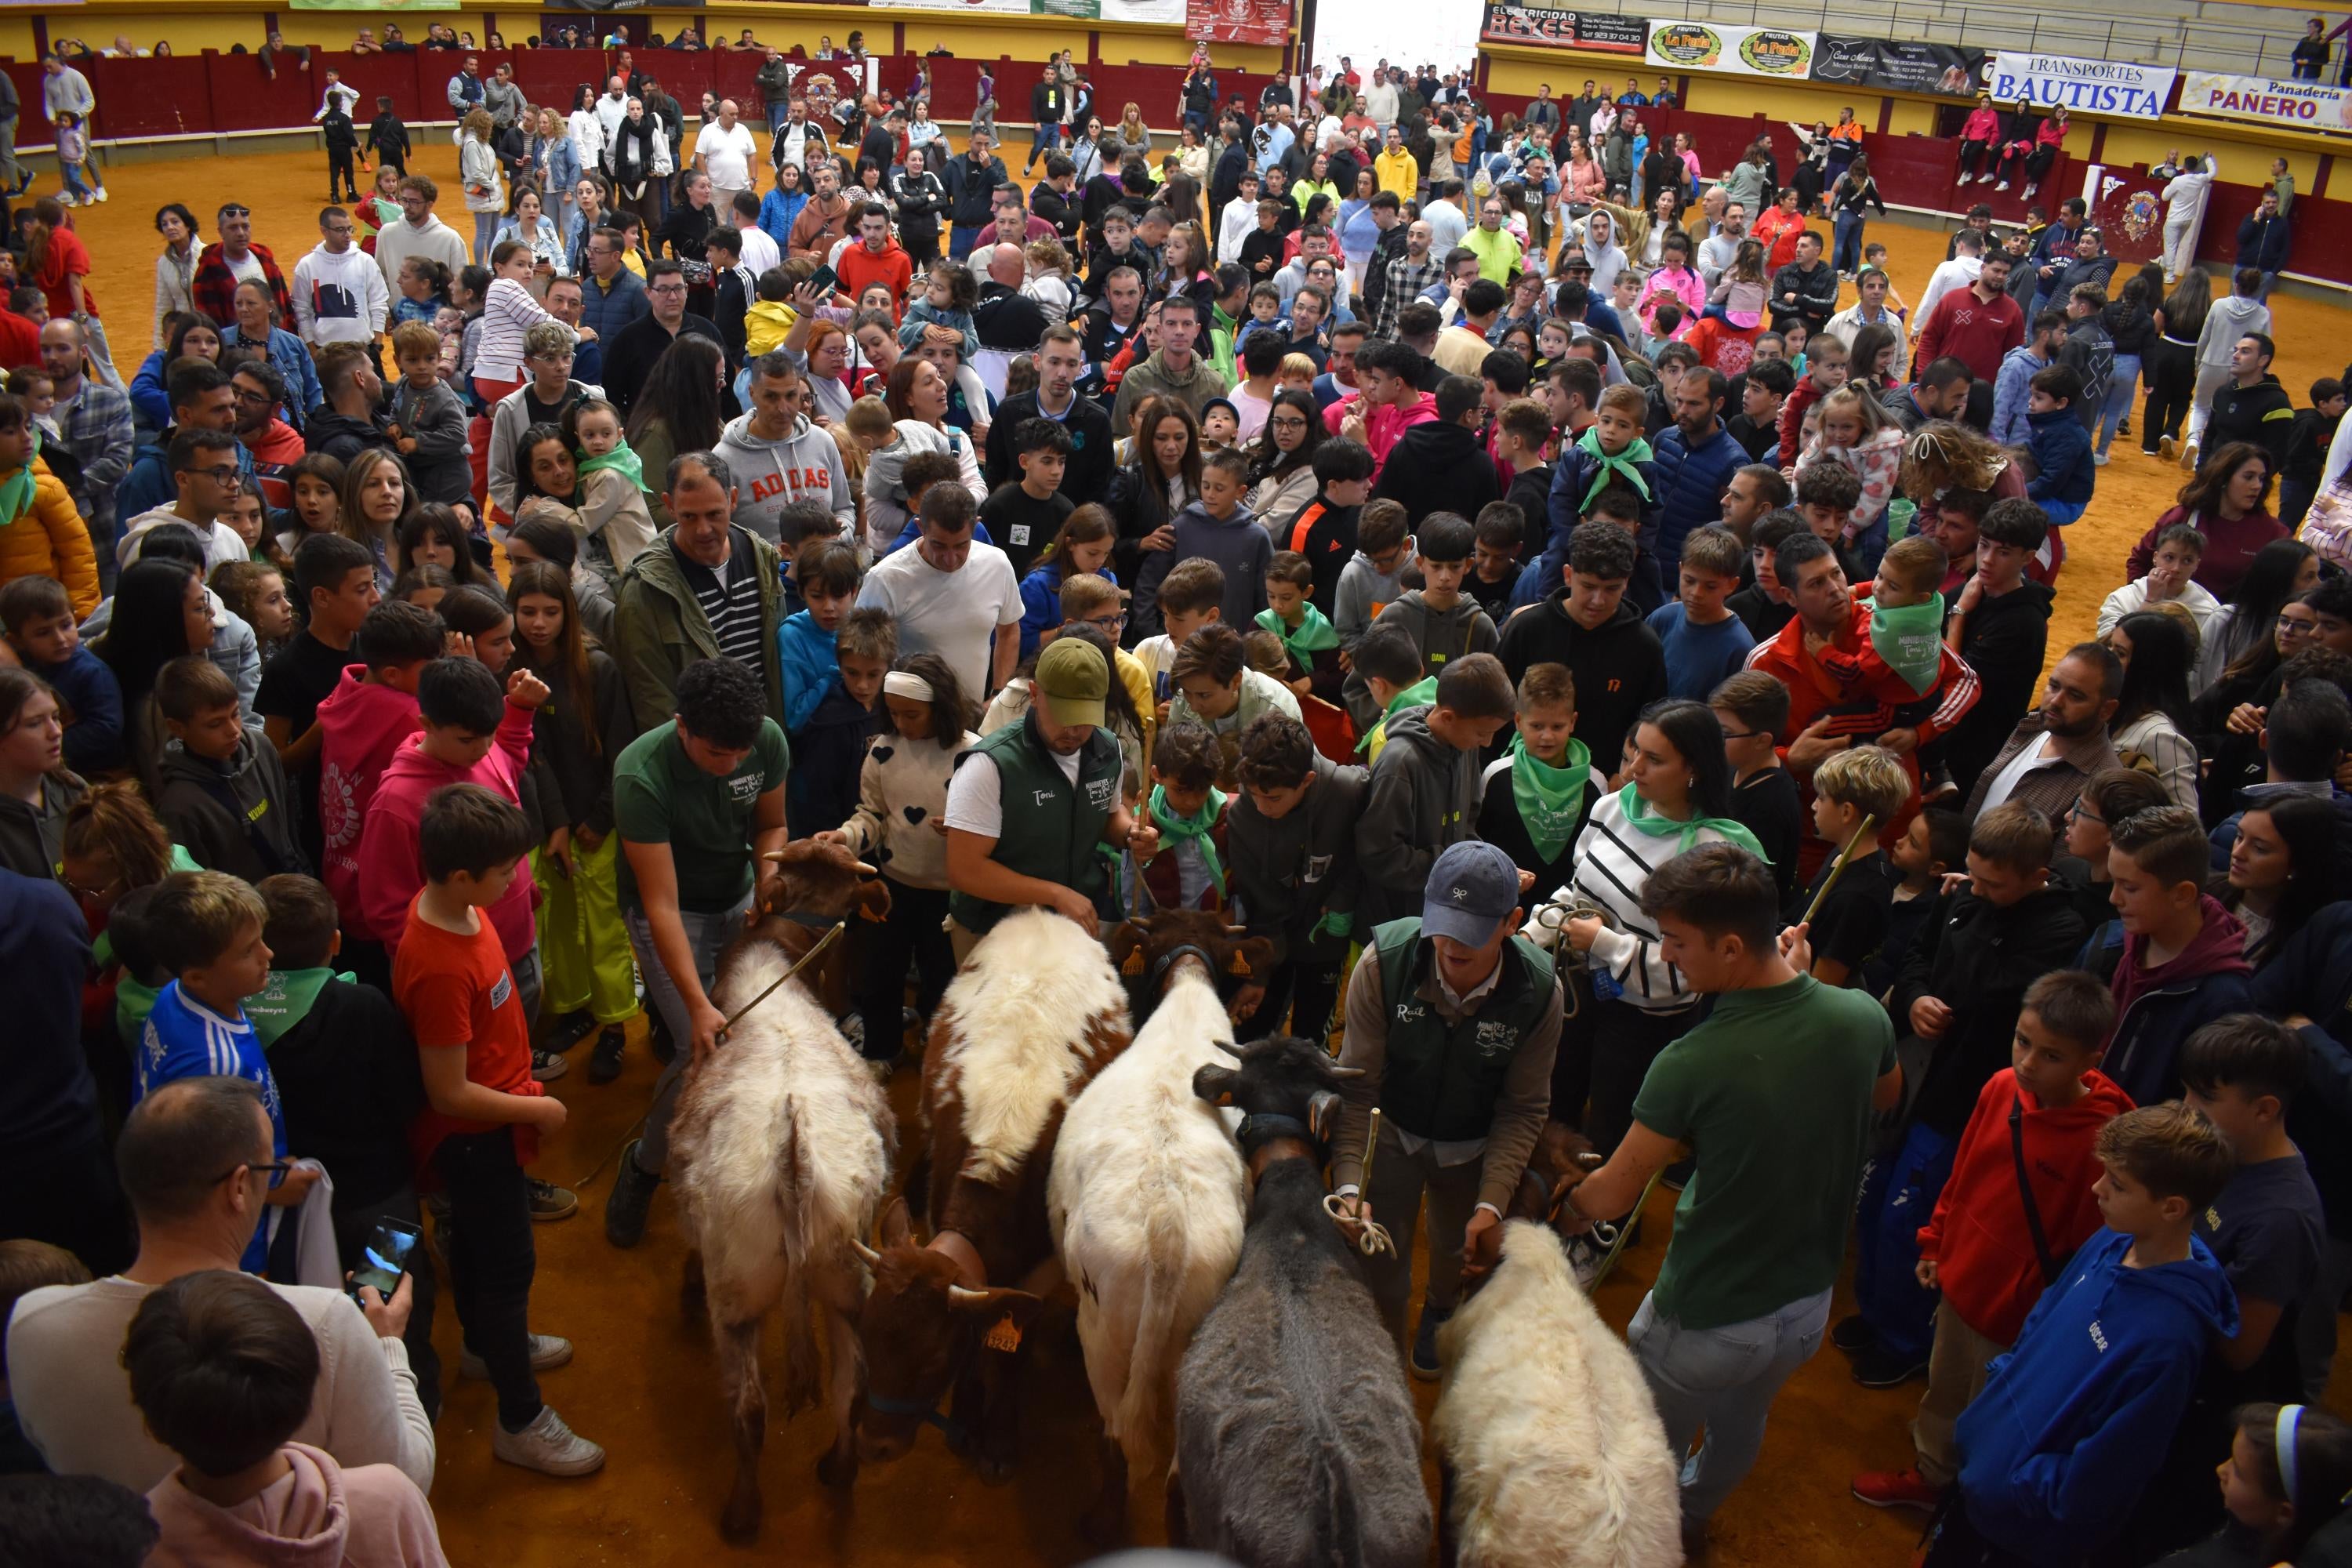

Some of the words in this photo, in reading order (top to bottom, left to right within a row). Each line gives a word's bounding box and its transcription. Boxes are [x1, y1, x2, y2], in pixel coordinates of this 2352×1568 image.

[1490, 14, 1576, 38] REYES
[1664, 34, 1679, 45] La
[1752, 40, 1766, 53] La
[1833, 50, 1849, 60] Casa
[2028, 57, 2143, 82] TRANSPORTES
[1994, 74, 2159, 116] BAUTISTA
[2267, 82, 2340, 100] Panadería
[2209, 88, 2317, 120] PAÑERO
[1431, 652, 1446, 662] DANI
[1607, 678, 1621, 692] 17
[1033, 789, 1055, 806] Toni
[990, 1336, 1015, 1351] 3242
